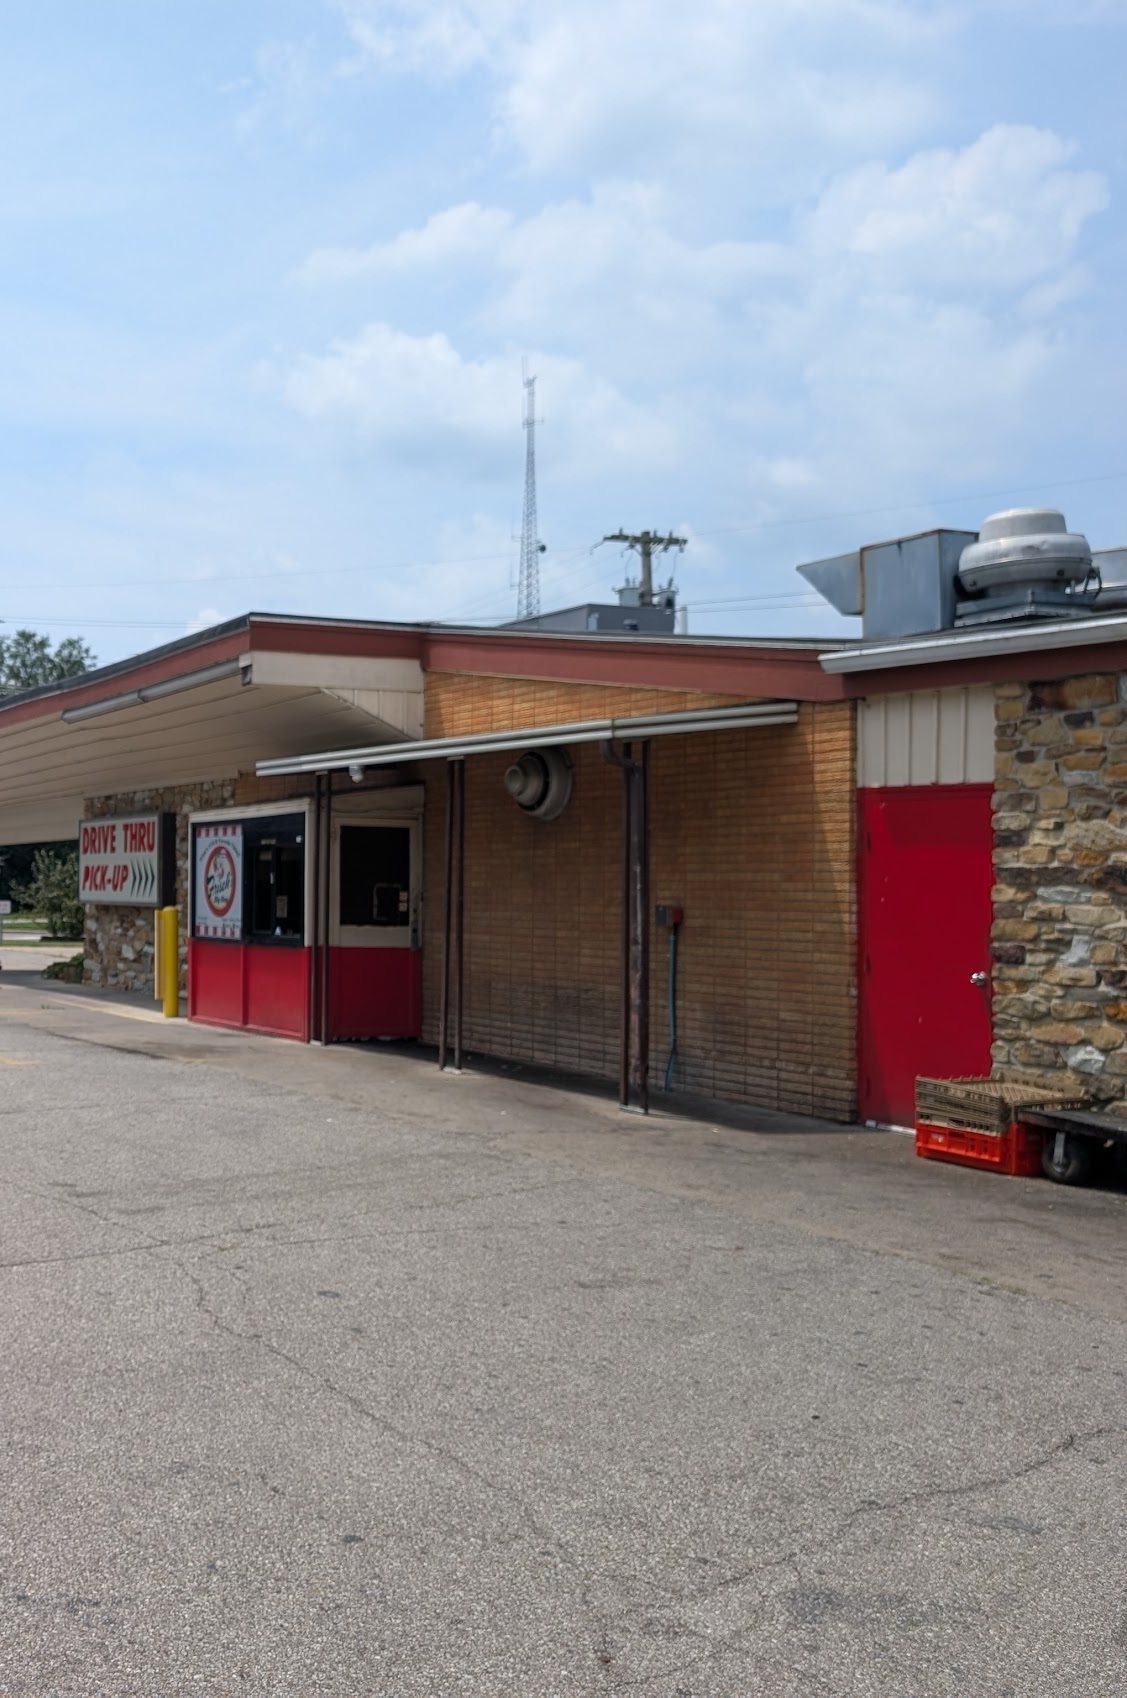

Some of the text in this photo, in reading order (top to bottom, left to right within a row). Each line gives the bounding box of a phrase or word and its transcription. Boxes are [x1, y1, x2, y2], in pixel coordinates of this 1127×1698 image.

[82, 821, 156, 855] DRIVE THRU
[82, 864, 129, 892] PICK-UP
